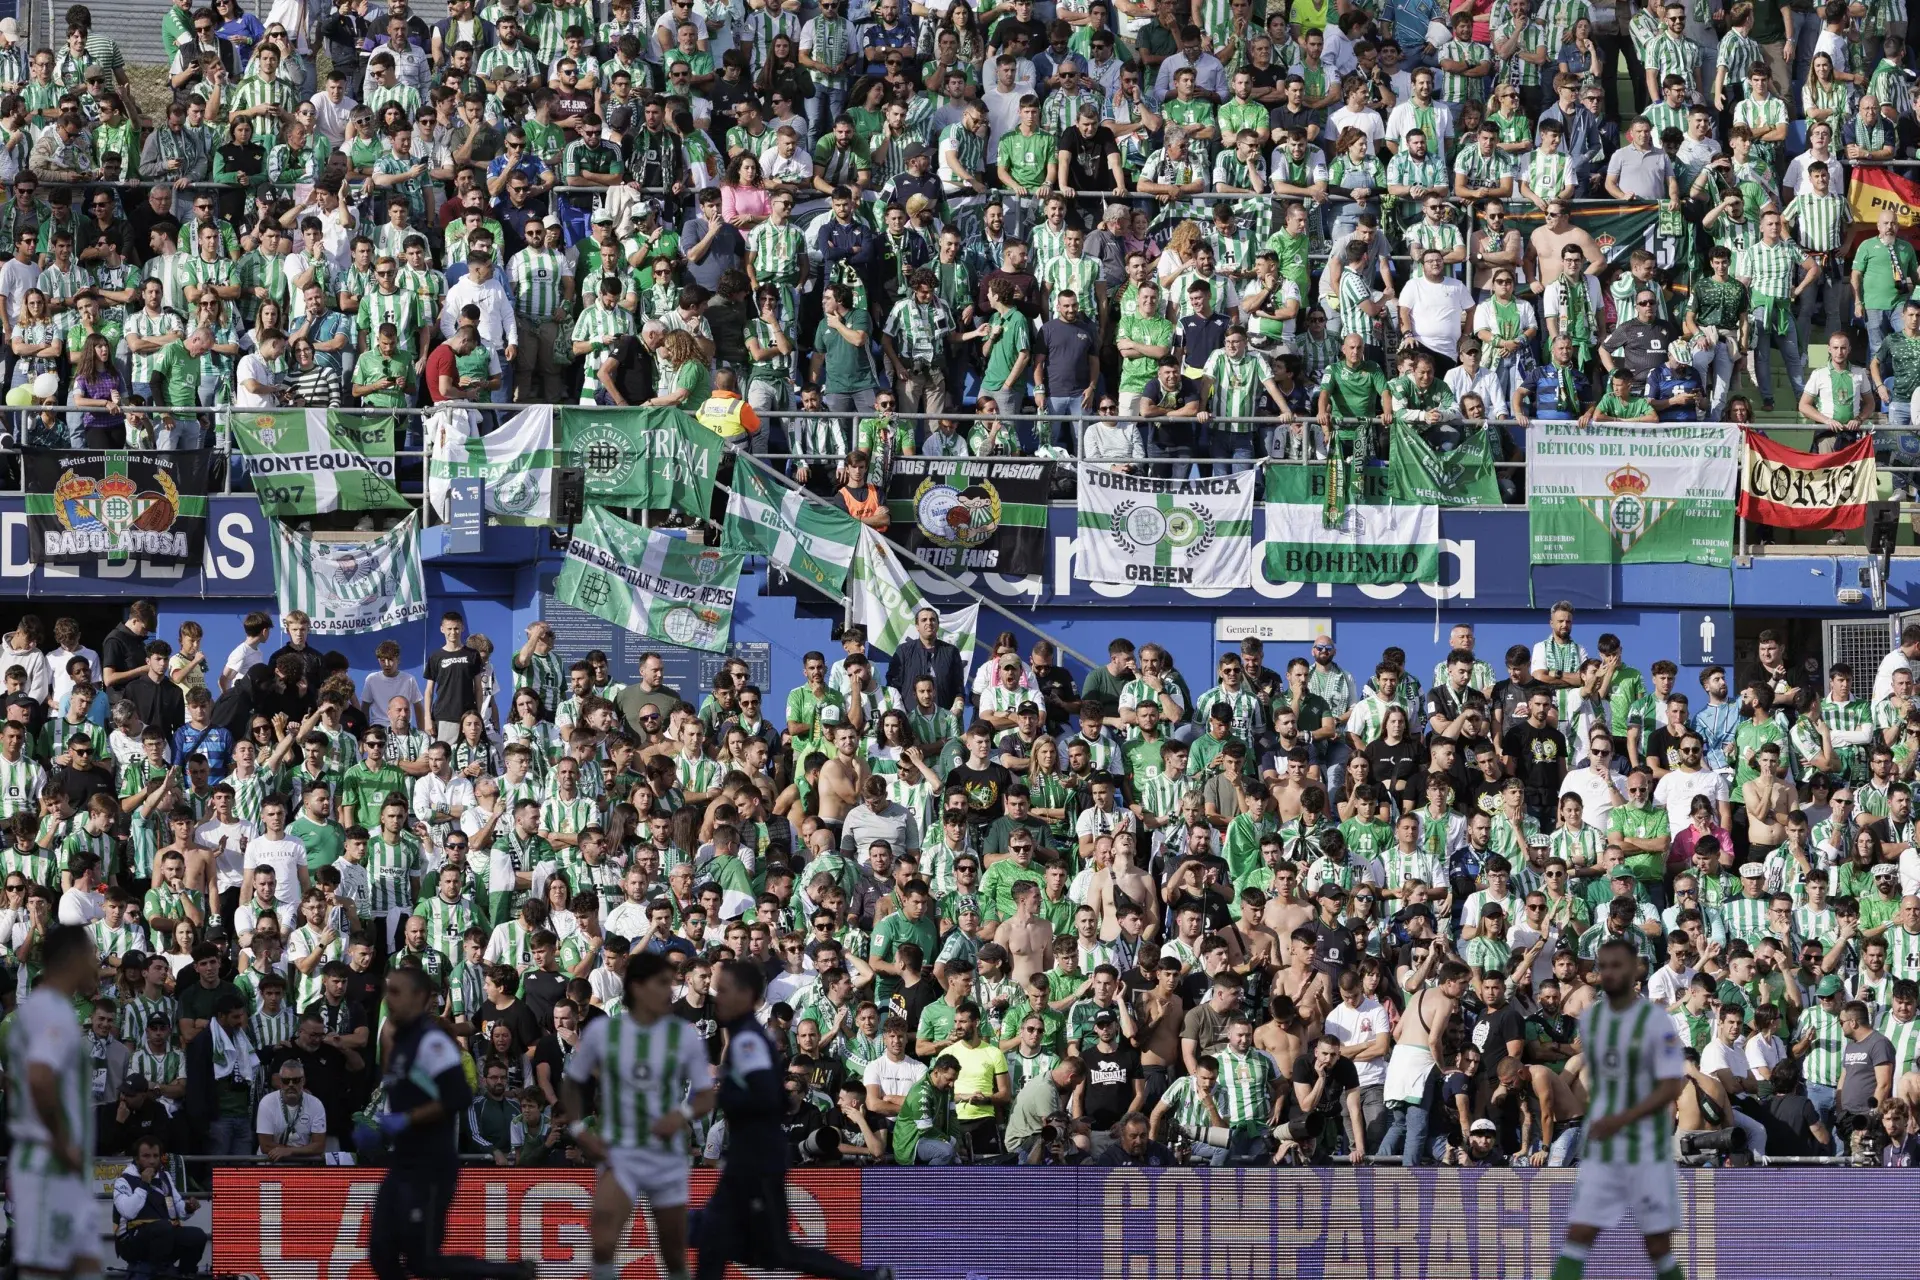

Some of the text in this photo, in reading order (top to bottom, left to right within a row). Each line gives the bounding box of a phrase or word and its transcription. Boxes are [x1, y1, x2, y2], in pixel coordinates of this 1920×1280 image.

[713, 425, 722, 434] 78
[1545, 424, 1582, 436] PEÑA
[1537, 441, 1732, 459] BÉTICOS DEL POLÍGONO SUR
[928, 461, 957, 475] POR
[960, 462, 989, 477] UNA
[1086, 468, 1241, 495] TORREBLANCA
[1533, 485, 1575, 494] FUNDADA
[1541, 497, 1565, 505] 2015
[44, 529, 188, 556] BADOLATOSA
[961, 549, 1000, 568] FANS
[1286, 550, 1418, 574] BOHEMIO
[1533, 552, 1579, 560] SENTIMIENTO
[570, 540, 595, 562] SAN
[654, 578, 671, 596] DE
[673, 583, 696, 600] LOS
[700, 586, 734, 606] REYES
[1125, 563, 1194, 584] GREEN
[1226, 625, 1258, 634] General
[1701, 656, 1714, 664] WC
[1091, 1069, 1127, 1084] LONSDALE
